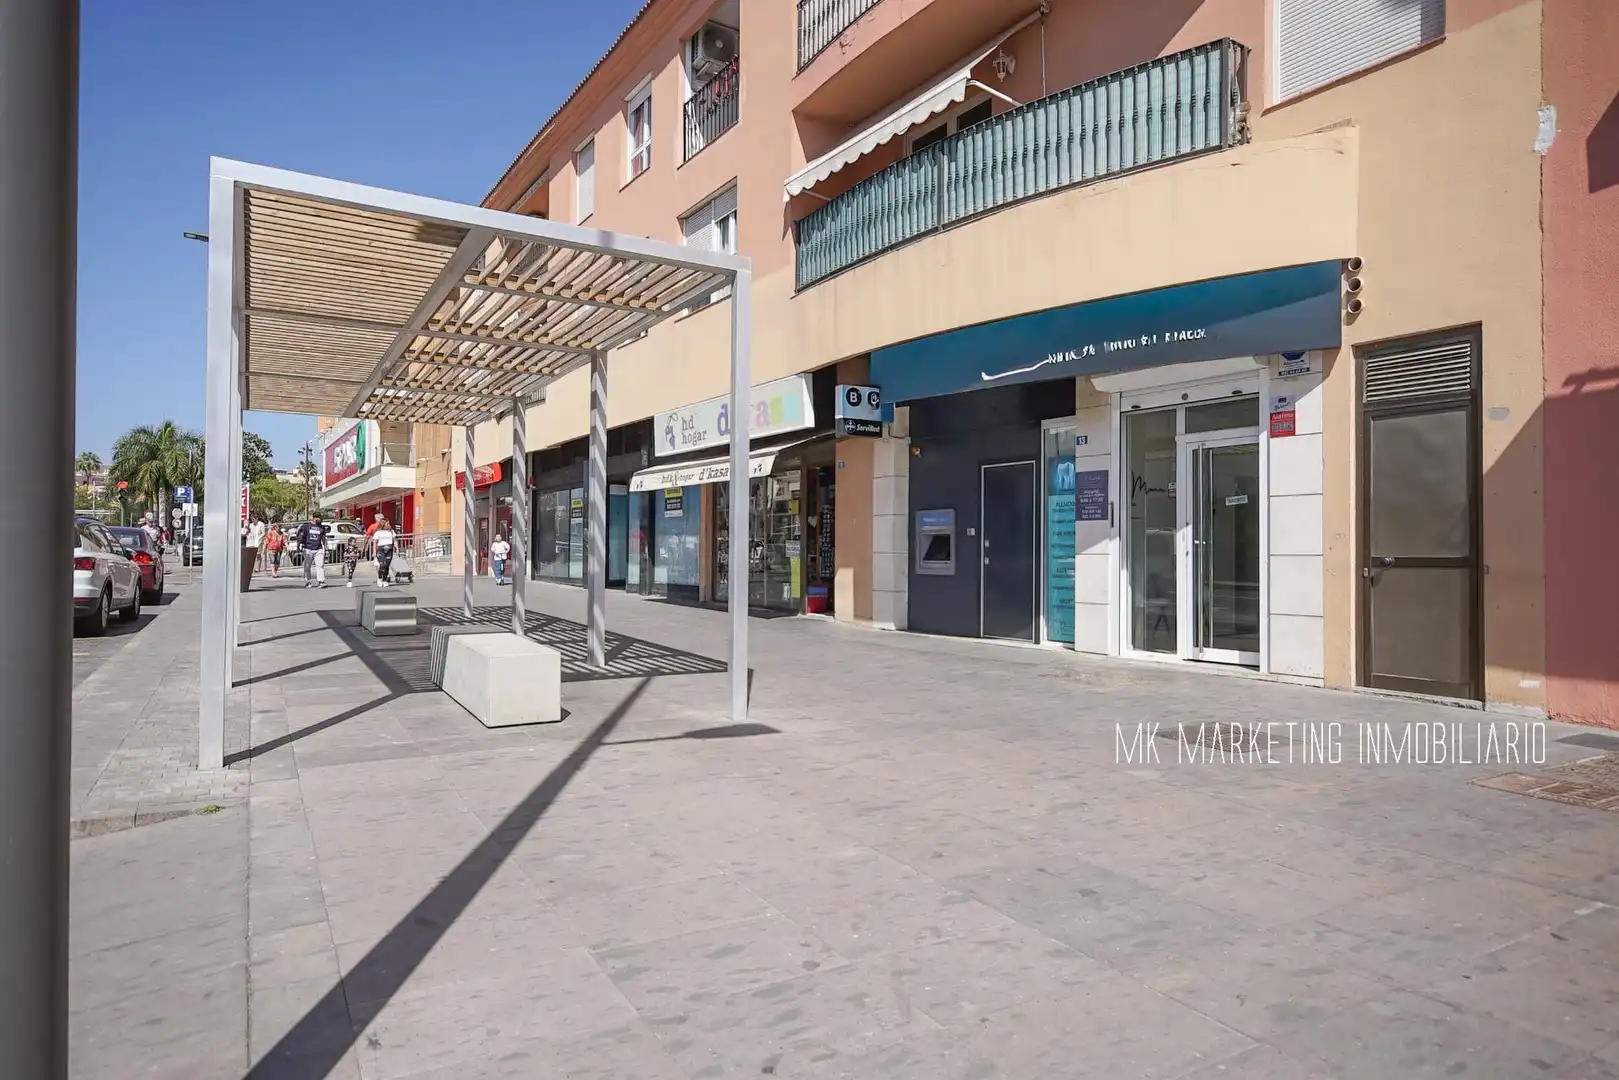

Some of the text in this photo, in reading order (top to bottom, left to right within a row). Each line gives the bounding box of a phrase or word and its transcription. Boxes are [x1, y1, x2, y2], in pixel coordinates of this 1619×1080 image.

[681, 415, 695, 431] hd
[682, 429, 708, 446] hogar
[1078, 437, 1087, 445] 13
[178, 487, 186, 497] P
